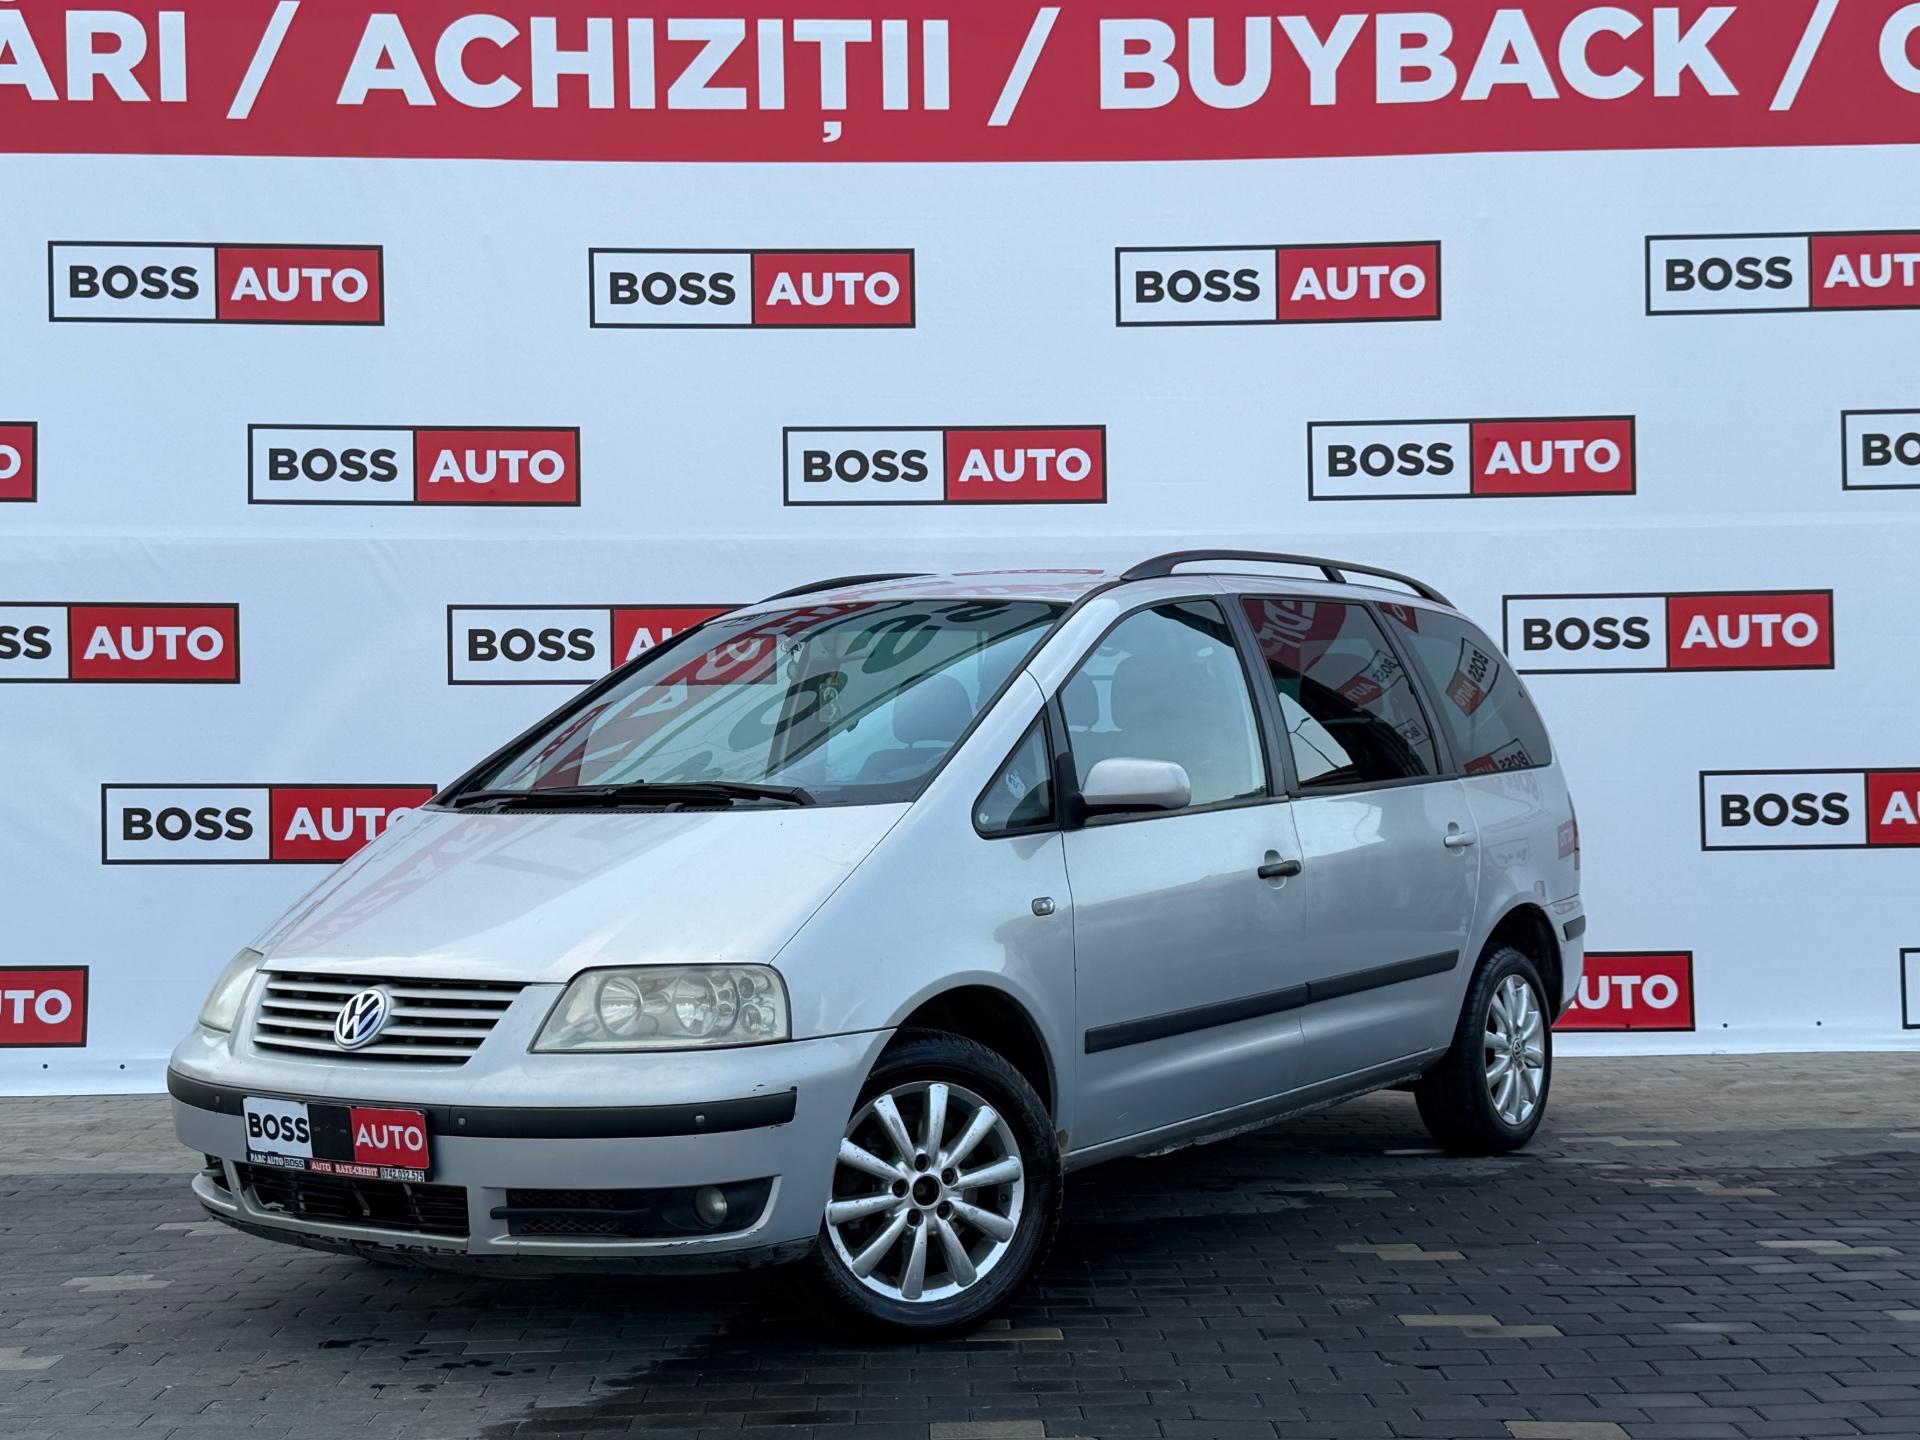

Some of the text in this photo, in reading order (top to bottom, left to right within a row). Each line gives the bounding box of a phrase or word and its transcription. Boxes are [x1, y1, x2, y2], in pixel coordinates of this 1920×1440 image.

[336, 13, 950, 143] ACHIZIȚII
[1099, 7, 1739, 110] BUYBACK
[69, 266, 369, 303] BOSS AUTO
[609, 271, 900, 306] BOSS AUTO
[1135, 265, 1426, 304] BOSS AUTO
[1665, 257, 1793, 292] BOSS
[268, 449, 565, 484] BOSS AUTO
[803, 448, 1092, 483] BOSS AUTO
[1327, 439, 1621, 477] BOSS AUTO
[83, 625, 224, 661] AUTO
[468, 628, 596, 662] BOSS
[1523, 613, 1819, 652] BOSS AUTO
[122, 807, 254, 841] BOSS
[1720, 793, 1850, 827] BOSS
[0, 989, 72, 1025] TO
[1568, 975, 1679, 1010] UTO
[247, 1112, 424, 1151] BOSS AUTO
[267, 1155, 284, 1167] AUTO
[311, 1161, 332, 1172] AUTO
